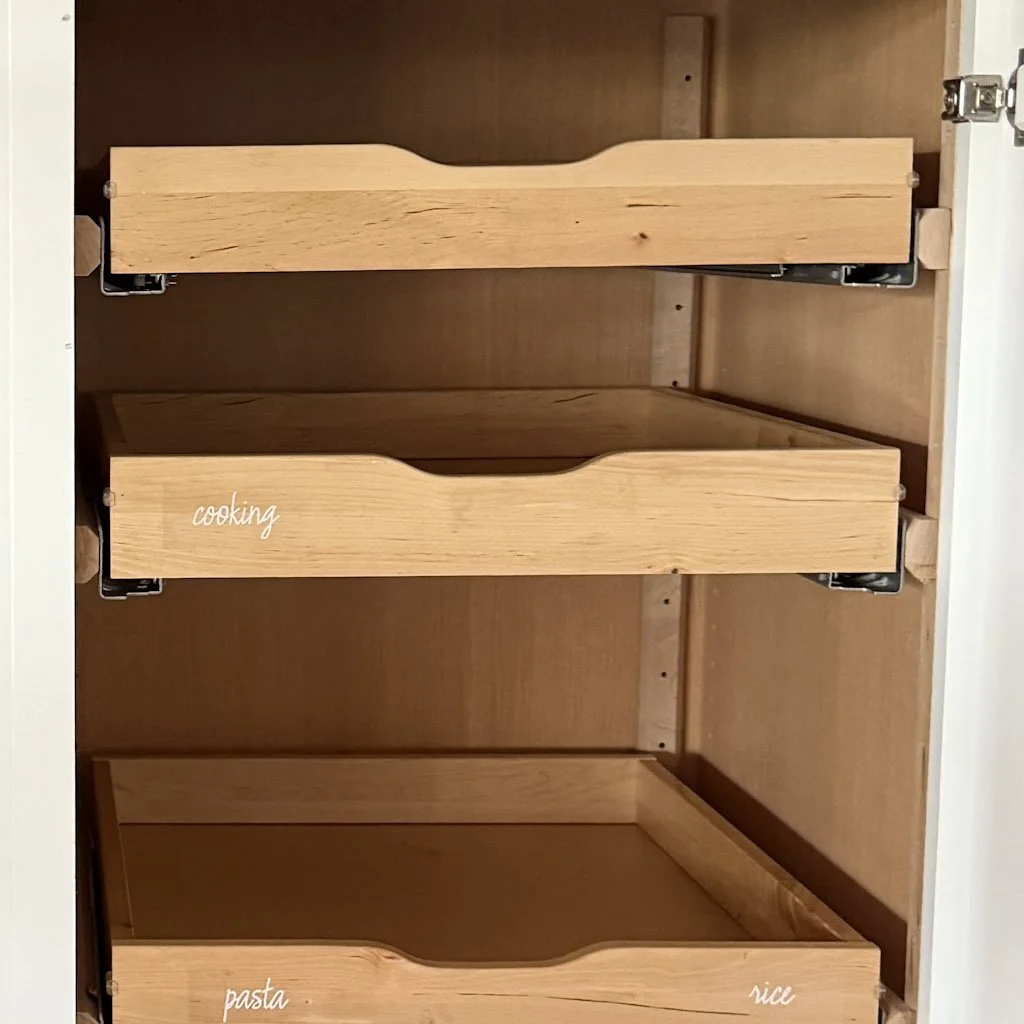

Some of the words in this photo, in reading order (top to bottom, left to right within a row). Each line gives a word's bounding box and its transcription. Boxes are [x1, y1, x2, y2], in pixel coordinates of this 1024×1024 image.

[192, 491, 280, 539] cooking
[222, 977, 289, 1022] pasta
[748, 980, 796, 1006] rice
